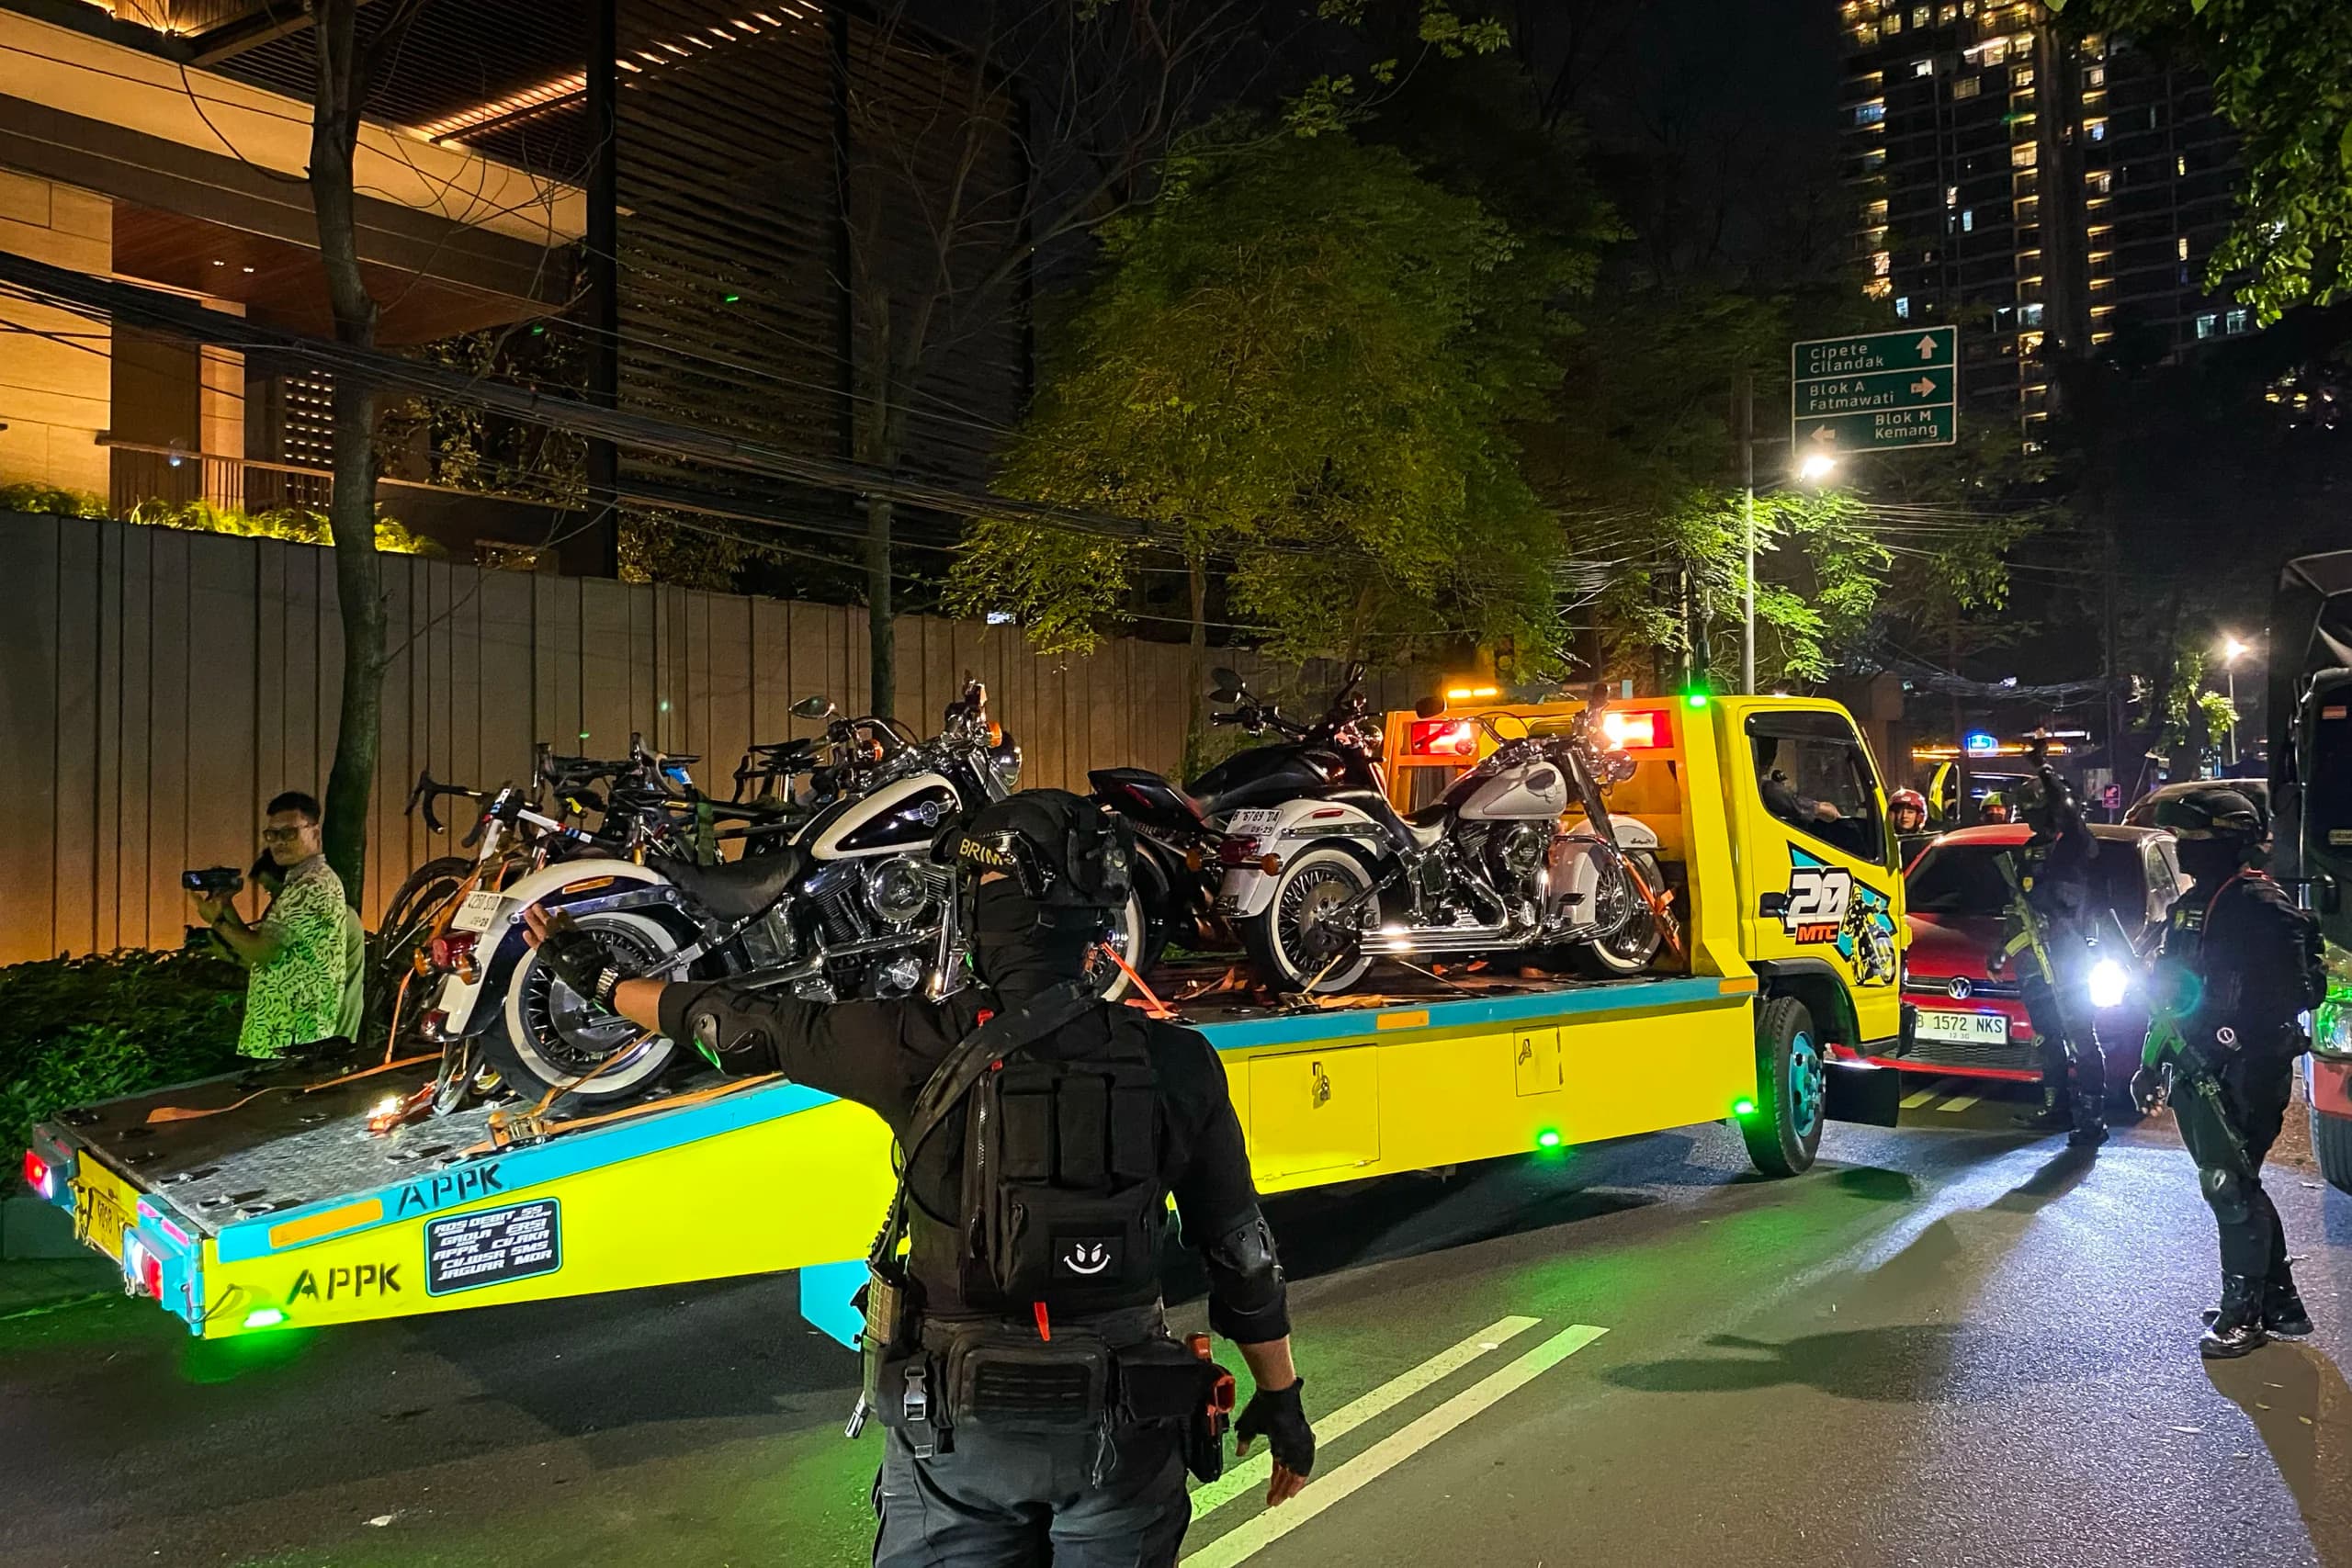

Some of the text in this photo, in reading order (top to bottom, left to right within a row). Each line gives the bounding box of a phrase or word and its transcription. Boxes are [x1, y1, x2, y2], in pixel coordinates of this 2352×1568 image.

[1810, 344, 1868, 362] Cipete
[1810, 355, 1883, 374] Cilandak
[1810, 381, 1865, 397] Blok A
[1810, 391, 1894, 411] Fatmawati
[1875, 411, 1931, 426] Blok M
[1875, 423, 1938, 439] Kemang
[1788, 873, 1850, 919] 20
[1798, 923, 1838, 942] MTC
[1917, 1014, 2003, 1033] B 1572 NKS
[397, 1163, 503, 1217] APPK
[433, 1244, 480, 1261] APPK
[437, 1259, 505, 1281] JAGUAR
[287, 1262, 402, 1306] APPK
